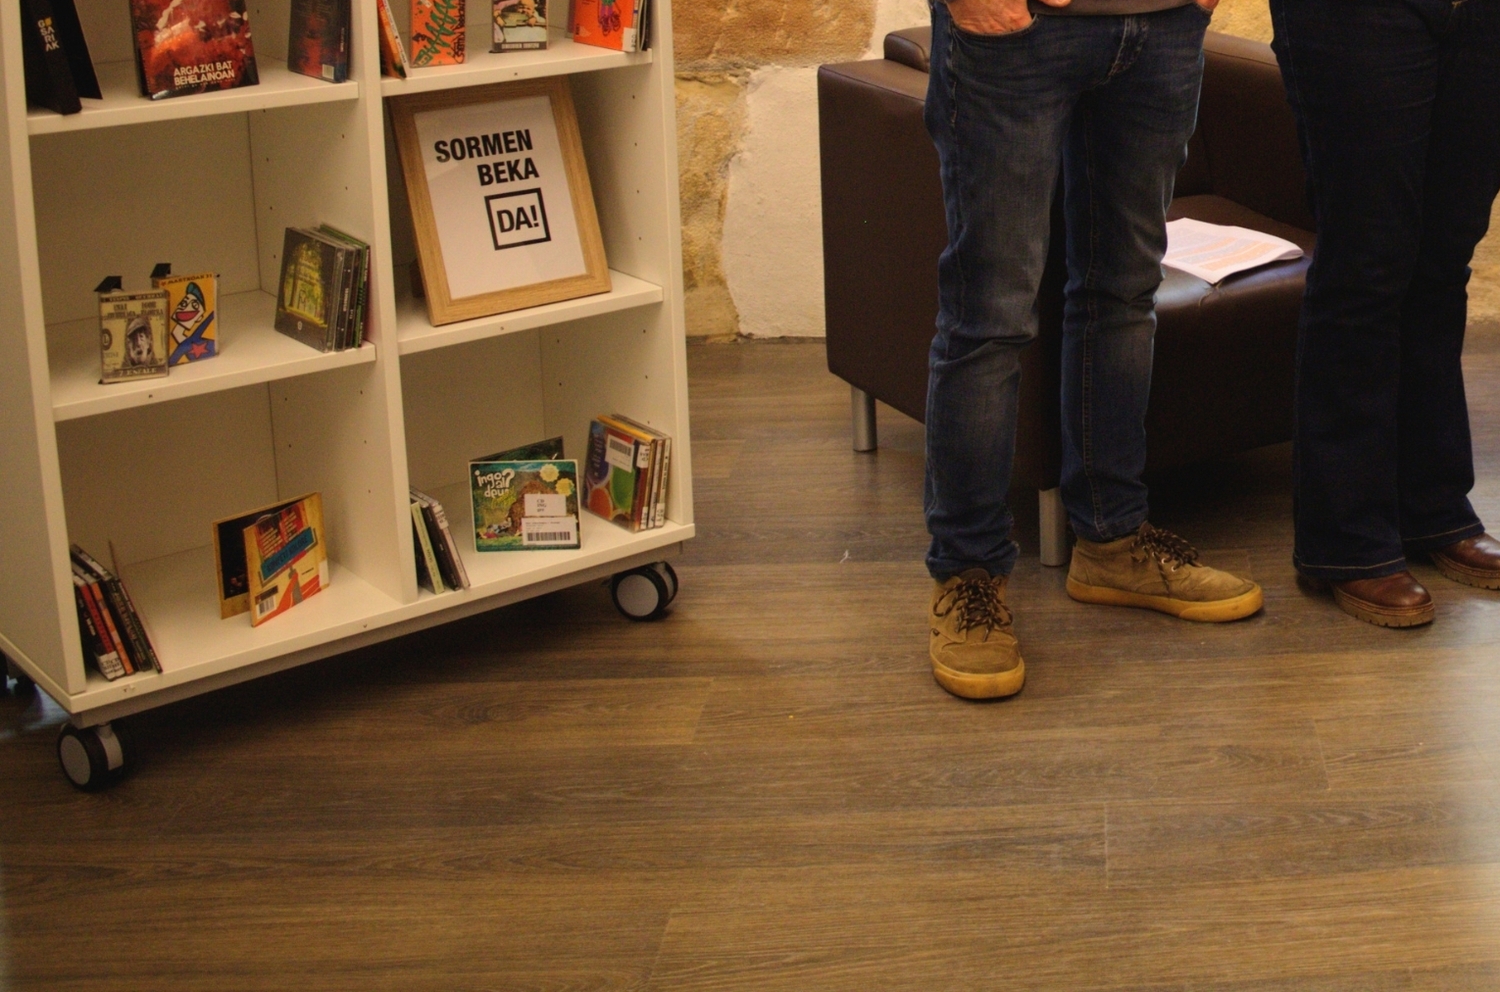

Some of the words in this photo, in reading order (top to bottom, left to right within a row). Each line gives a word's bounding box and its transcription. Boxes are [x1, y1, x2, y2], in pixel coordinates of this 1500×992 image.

[174, 62, 214, 77] ARGAZKI
[215, 60, 233, 71] BAT
[174, 69, 235, 86] BEHELAINOAN
[434, 129, 533, 163] SORMEN
[477, 157, 540, 186] BEKA
[496, 205, 539, 233] DA!
[474, 469, 503, 489] ingo
[495, 478, 506, 489] al
